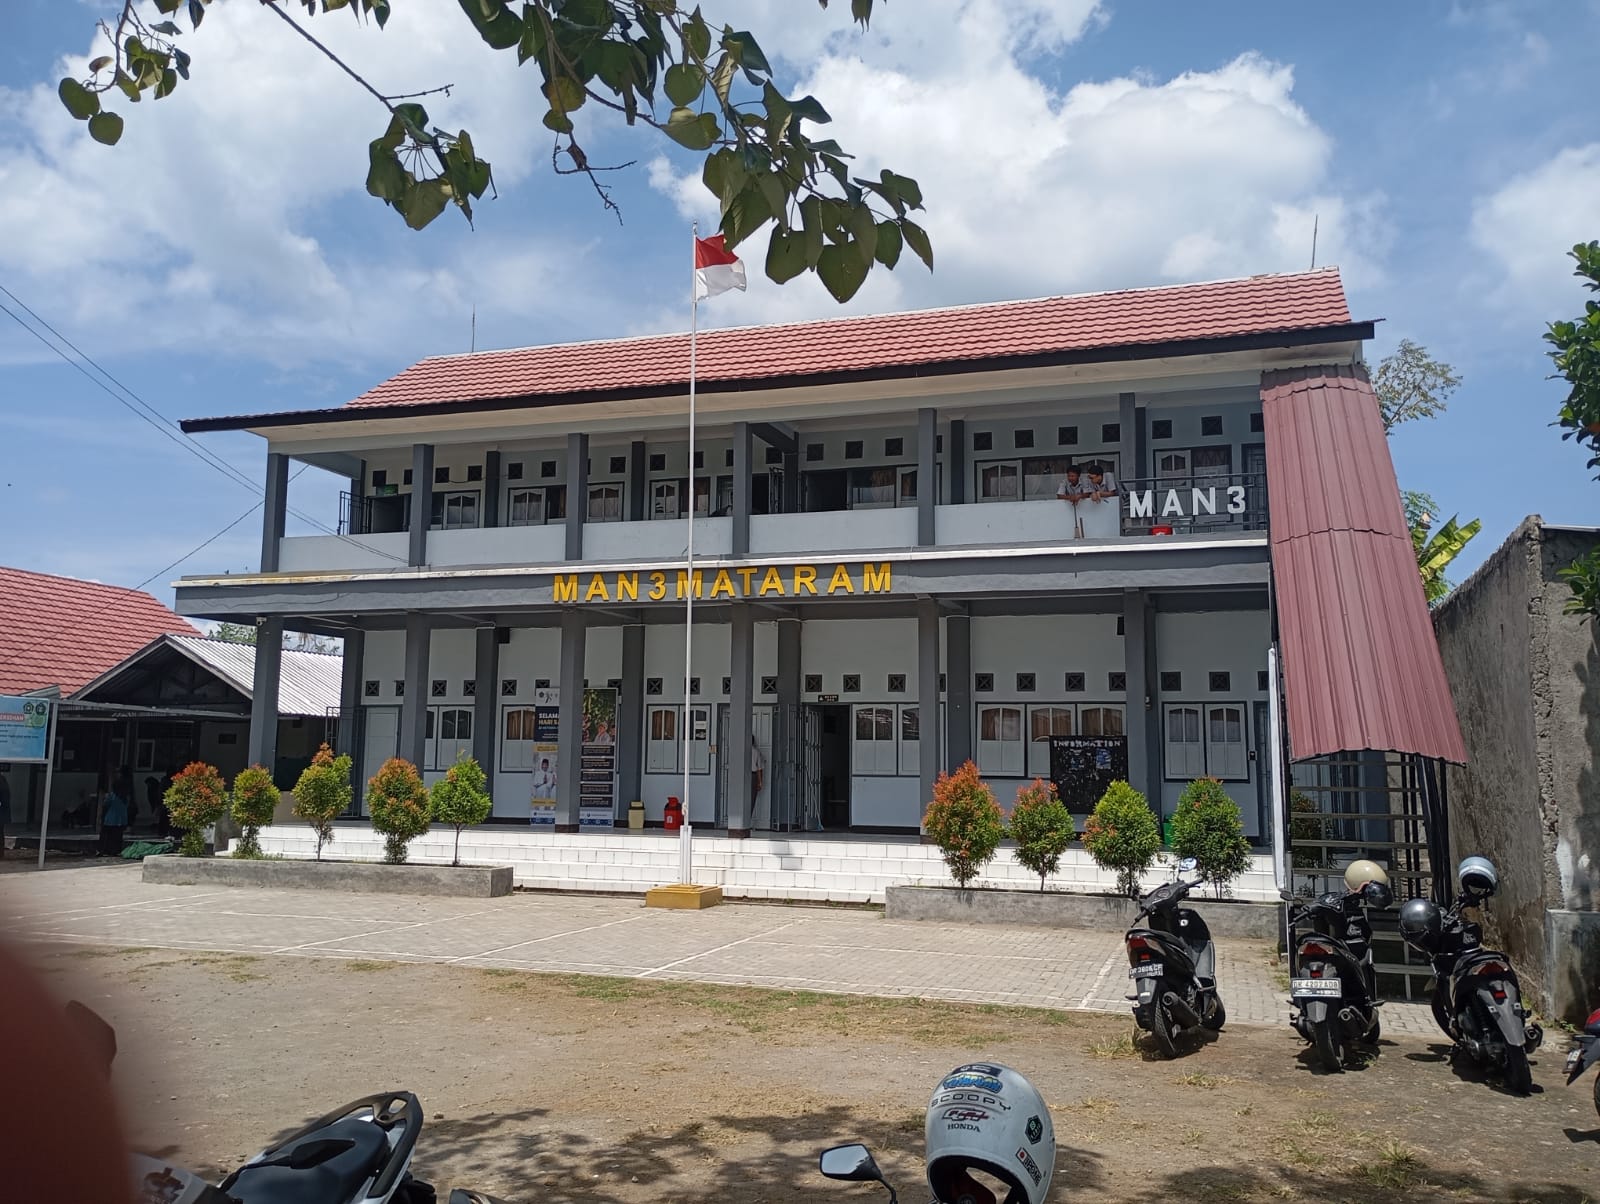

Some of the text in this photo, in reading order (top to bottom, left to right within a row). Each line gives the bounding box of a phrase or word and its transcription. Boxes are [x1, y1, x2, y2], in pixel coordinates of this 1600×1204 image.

[1129, 485, 1246, 518] MAN 3
[552, 562, 893, 603] MAN 3 MATARAM
[931, 1094, 1012, 1111] SCOOPY
[947, 1123, 981, 1133] HONDA
